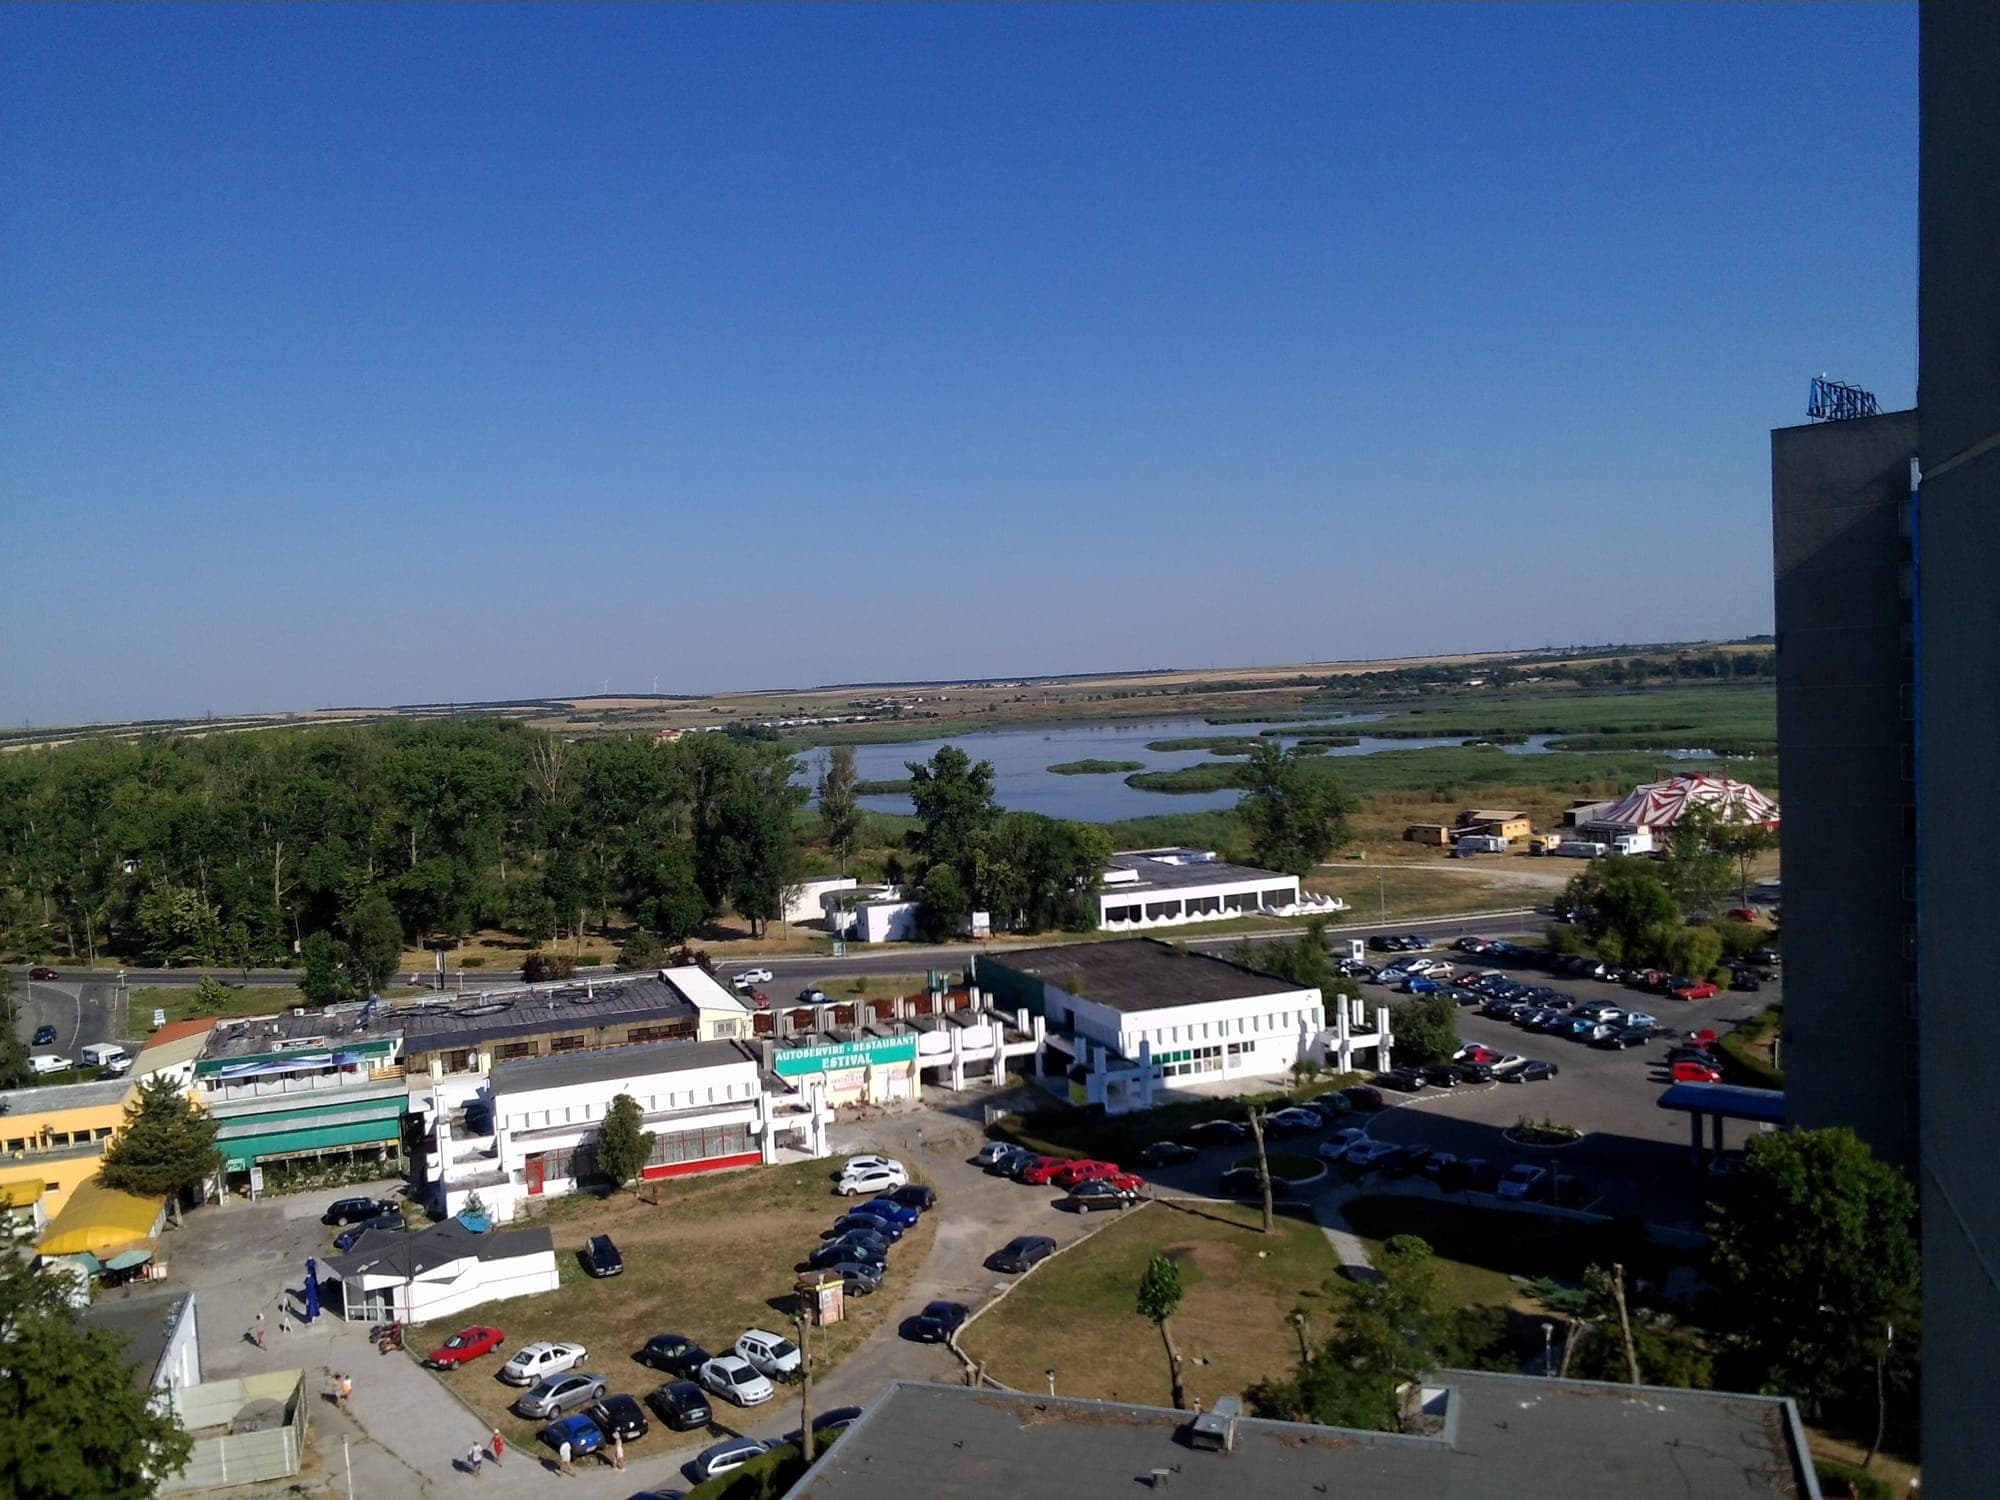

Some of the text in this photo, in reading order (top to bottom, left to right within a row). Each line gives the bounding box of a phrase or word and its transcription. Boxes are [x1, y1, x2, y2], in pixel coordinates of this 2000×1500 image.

[776, 1045, 845, 1061] AUTOSERVIRE
[853, 1036, 915, 1053] RESTAURANT
[822, 1053, 873, 1069] ESTIVAL
